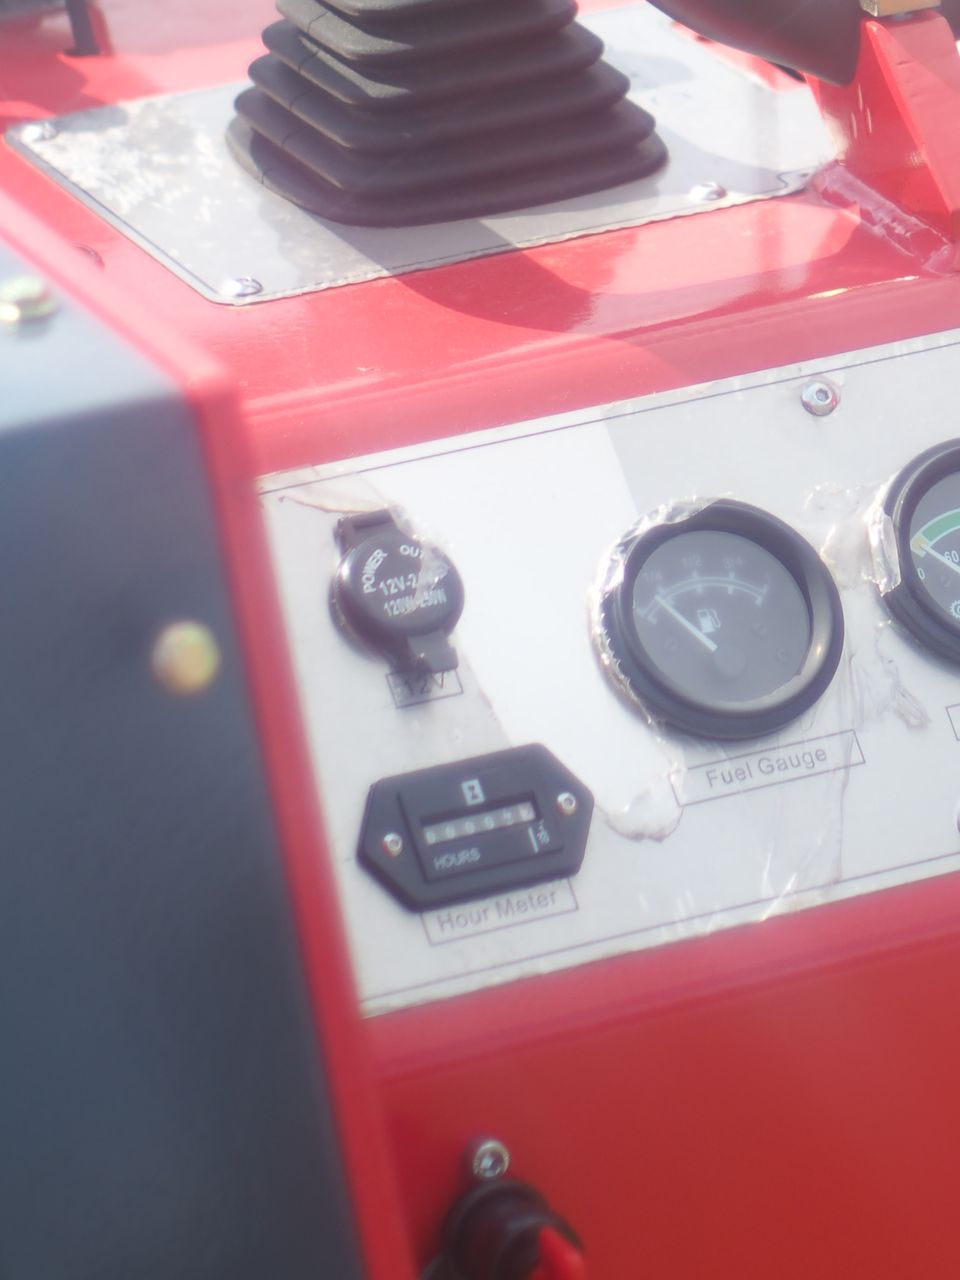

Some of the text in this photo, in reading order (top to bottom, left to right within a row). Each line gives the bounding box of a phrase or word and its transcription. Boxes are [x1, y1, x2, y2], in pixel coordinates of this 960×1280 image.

[705, 745, 828, 788] Fuel Gauge
[433, 846, 482, 870] HOURS
[436, 888, 559, 934] Hour Meter
